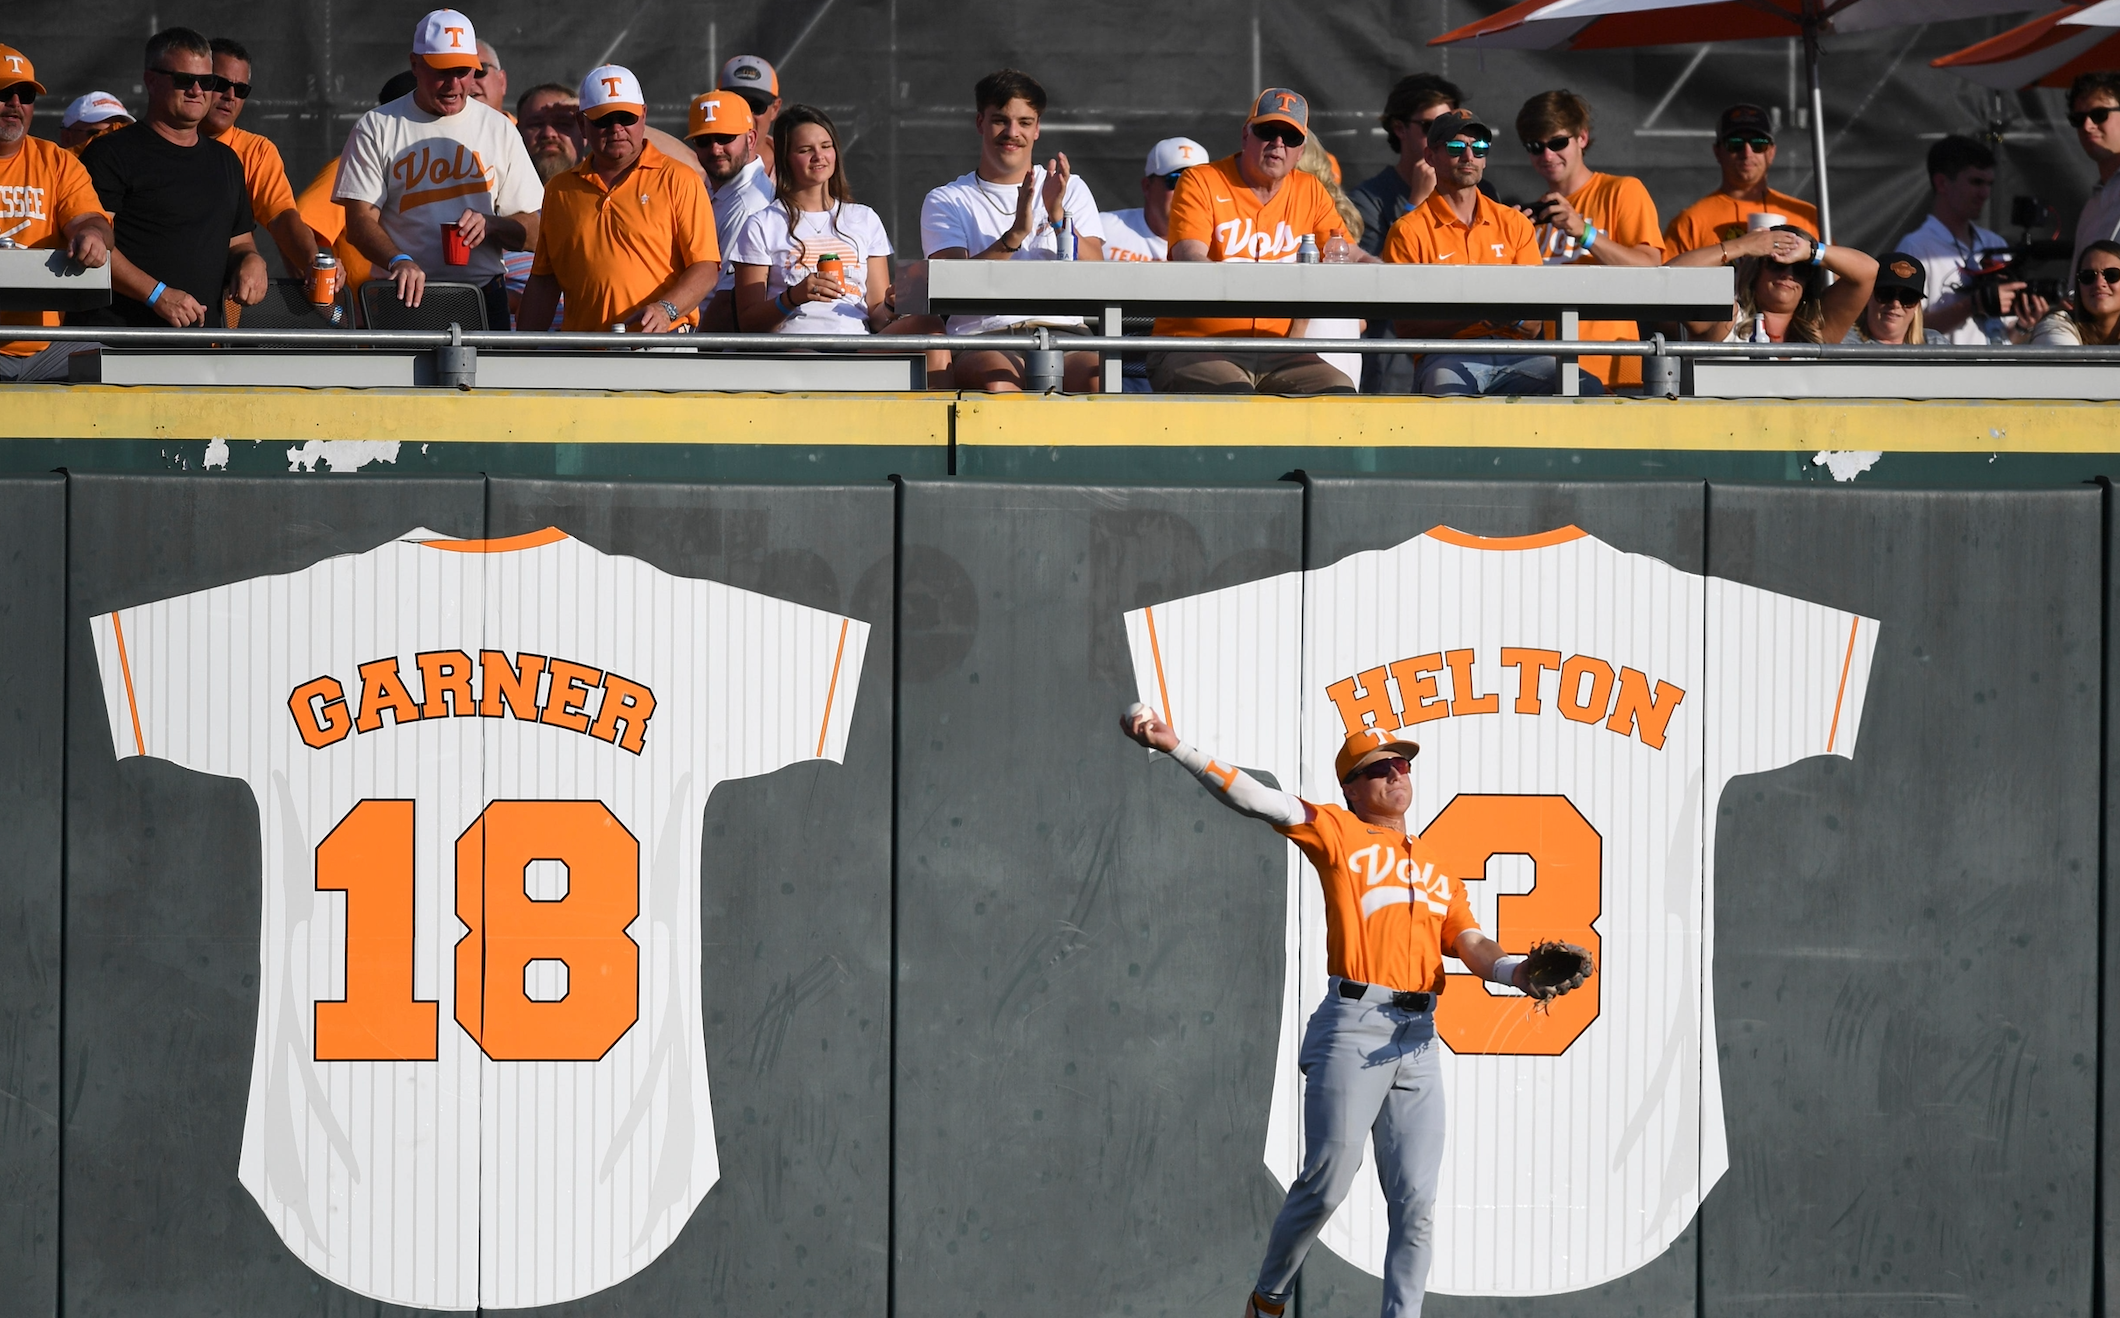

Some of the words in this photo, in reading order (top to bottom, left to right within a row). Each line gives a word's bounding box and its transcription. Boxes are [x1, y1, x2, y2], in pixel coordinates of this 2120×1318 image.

[444, 26, 464, 48] T
[5, 55, 24, 74] T
[601, 76, 622, 98] T
[700, 100, 721, 122] T
[1275, 92, 1298, 113] T
[1178, 144, 1193, 159] T
[393, 145, 494, 190] Vols
[1215, 218, 1302, 260] Vols
[1490, 243, 1506, 258] T
[287, 648, 657, 756] GARNER
[1325, 646, 1686, 751] HELTON
[1364, 727, 1393, 746] T
[1348, 843, 1453, 901] Vols
[313, 798, 640, 1062] 18
[1419, 793, 1603, 1057] 3
